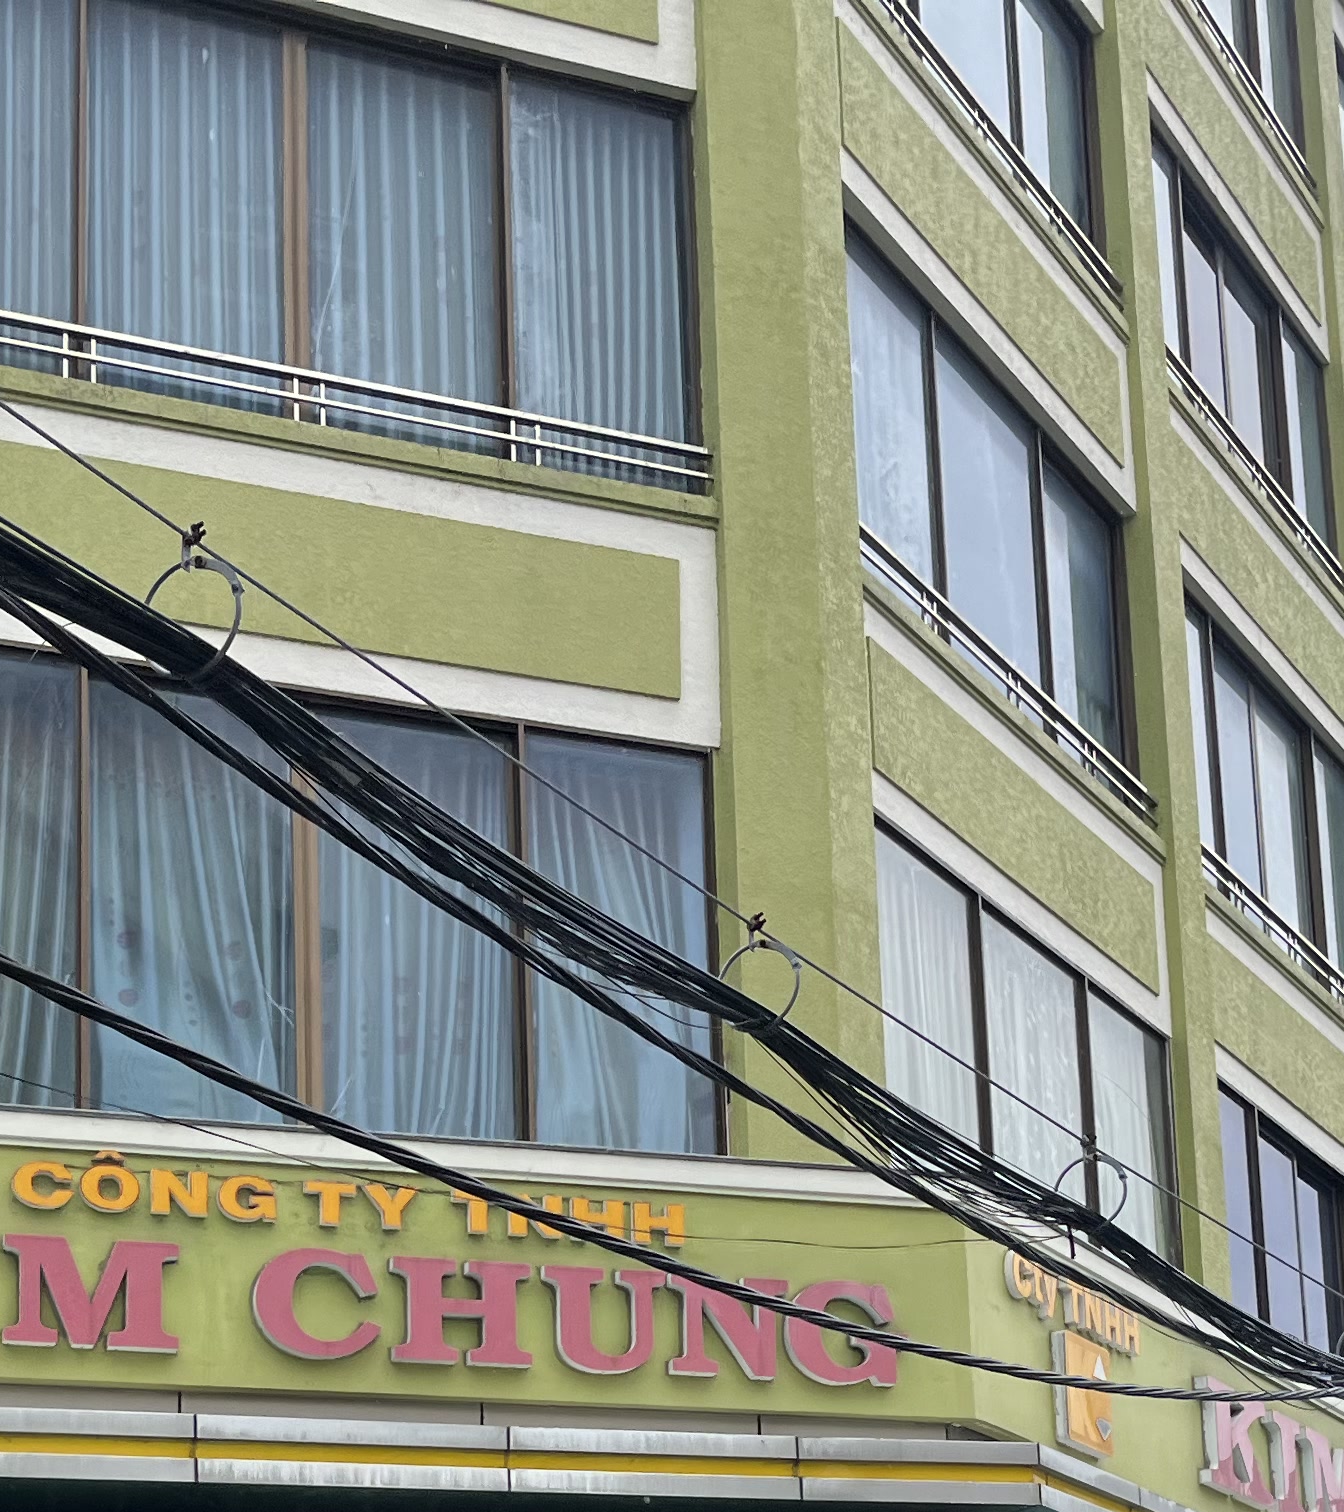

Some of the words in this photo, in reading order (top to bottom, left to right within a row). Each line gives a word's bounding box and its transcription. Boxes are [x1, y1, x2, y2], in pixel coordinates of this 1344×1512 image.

[11, 1151, 278, 1224] CÔNG
[303, 1180, 419, 1231] TY
[451, 1188, 686, 1248] TNHH
[251, 1247, 908, 1389] CHUNG
[1003, 1248, 1059, 1322] Cty
